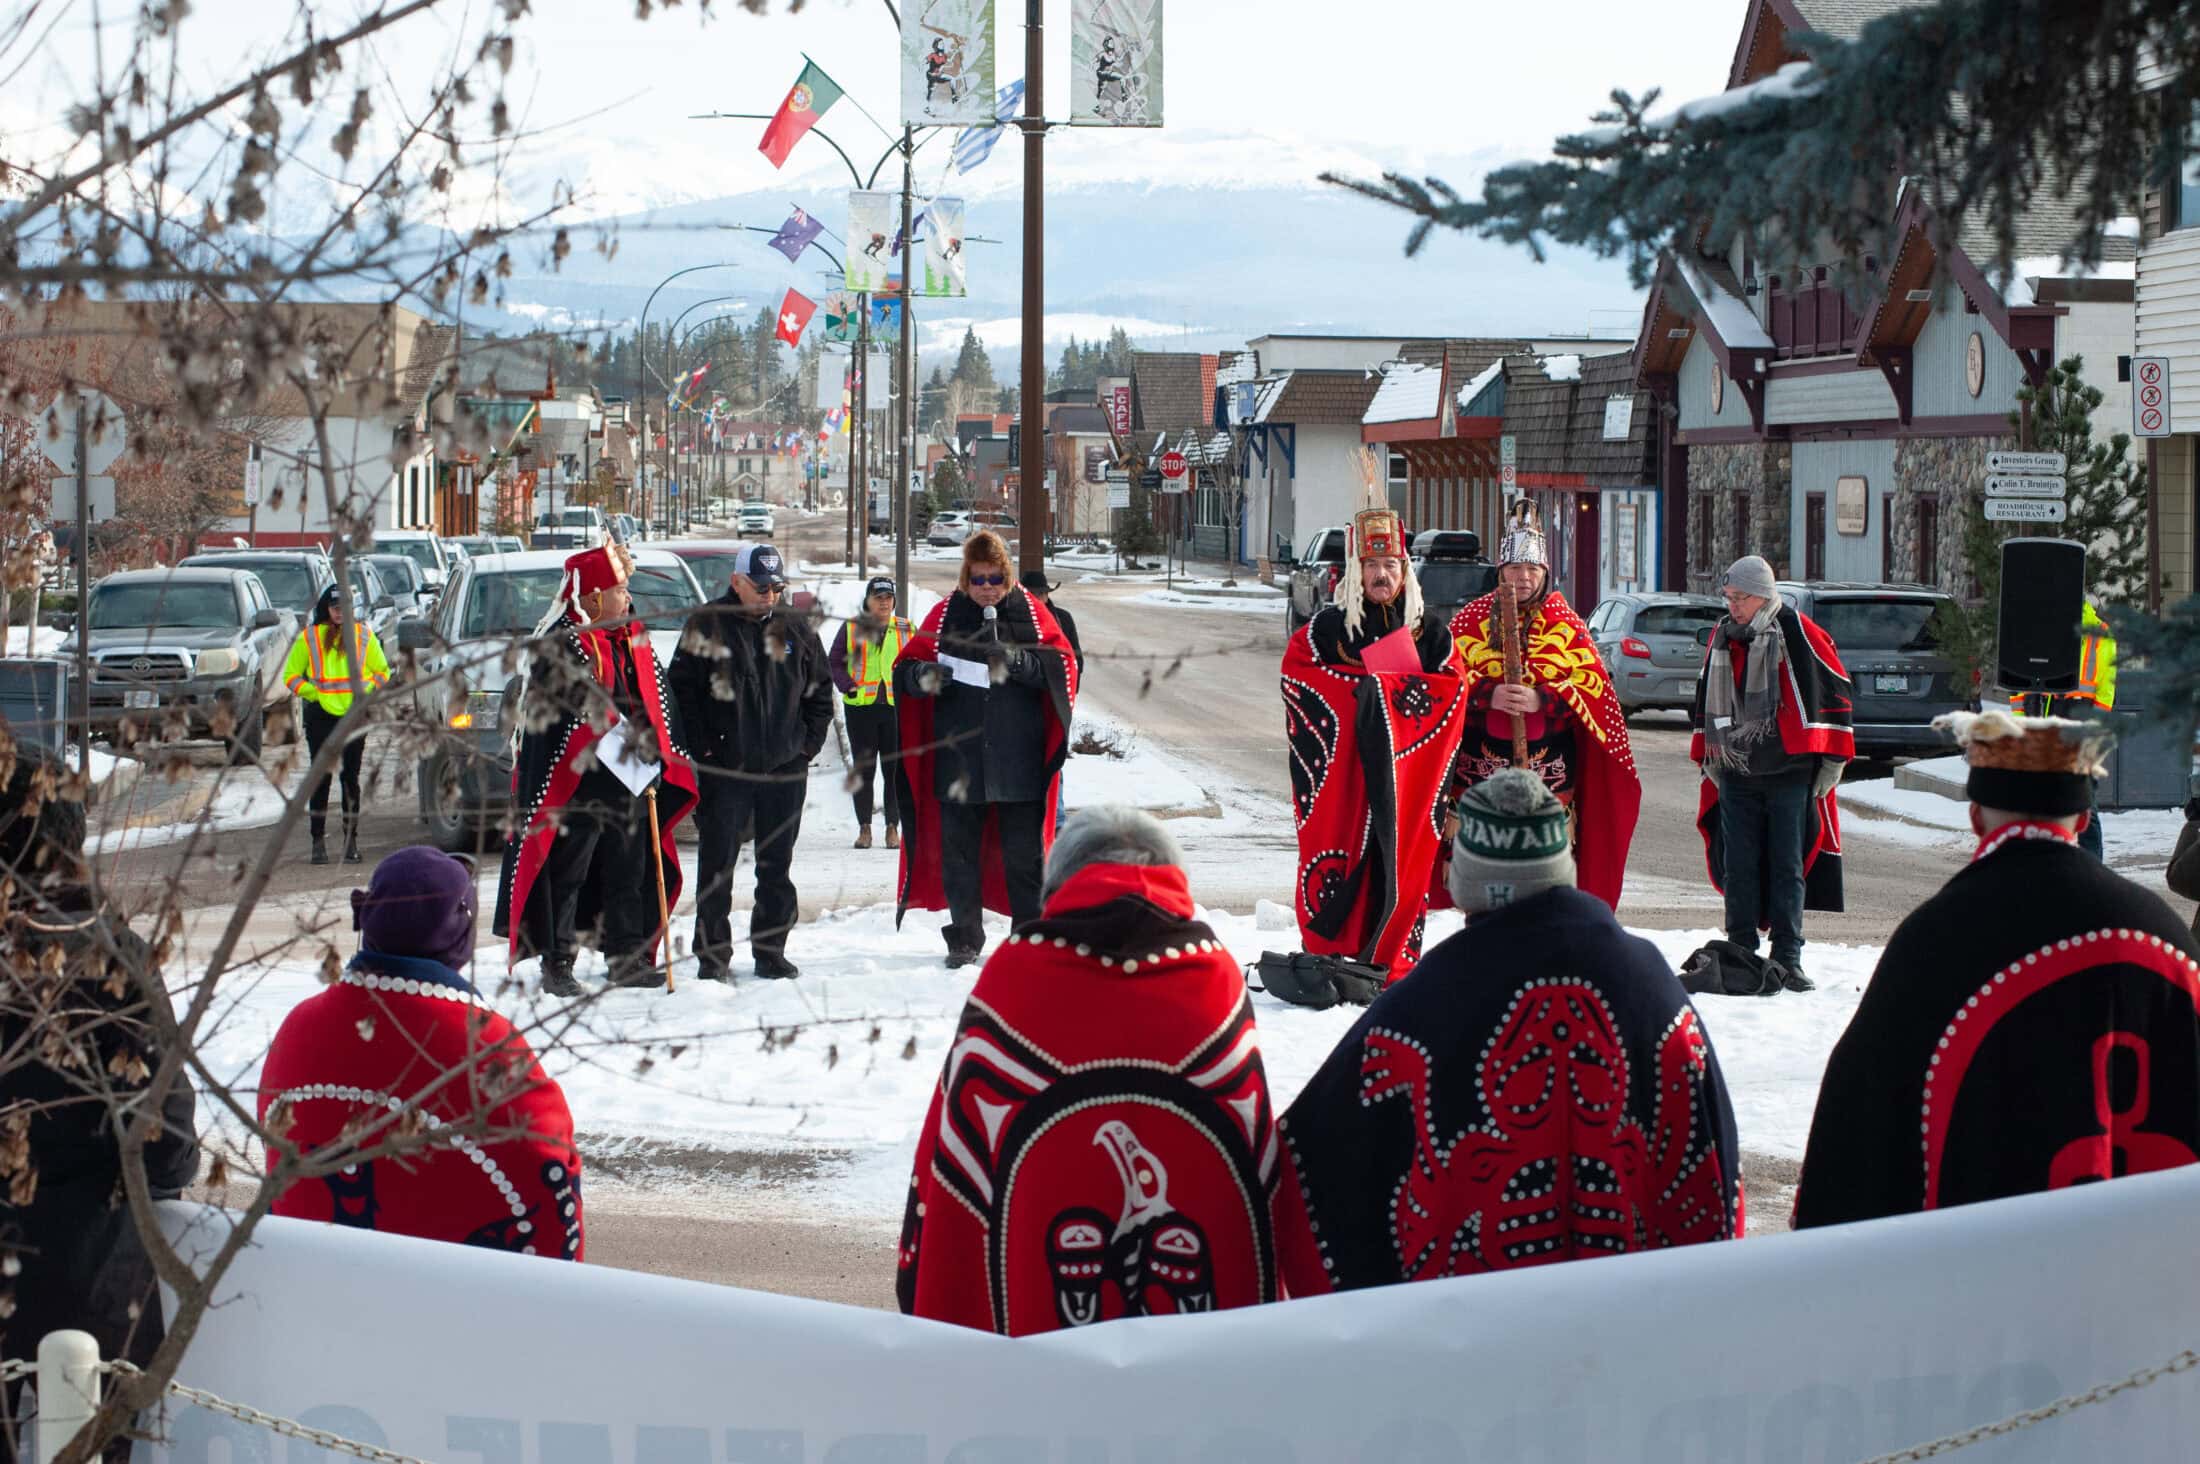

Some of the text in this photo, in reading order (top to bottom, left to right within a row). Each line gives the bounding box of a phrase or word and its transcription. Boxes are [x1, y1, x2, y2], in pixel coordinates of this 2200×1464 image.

[1116, 395, 1129, 430] CAFE
[1161, 459, 1186, 470] STOP
[2000, 456, 2058, 467] Investors Group
[1998, 479, 2018, 488] Colin
[2018, 480, 2026, 488] T.
[1996, 510, 2046, 518] RESTAURANT
[1462, 813, 1563, 850] HAWAII
[1485, 880, 1515, 908] H
